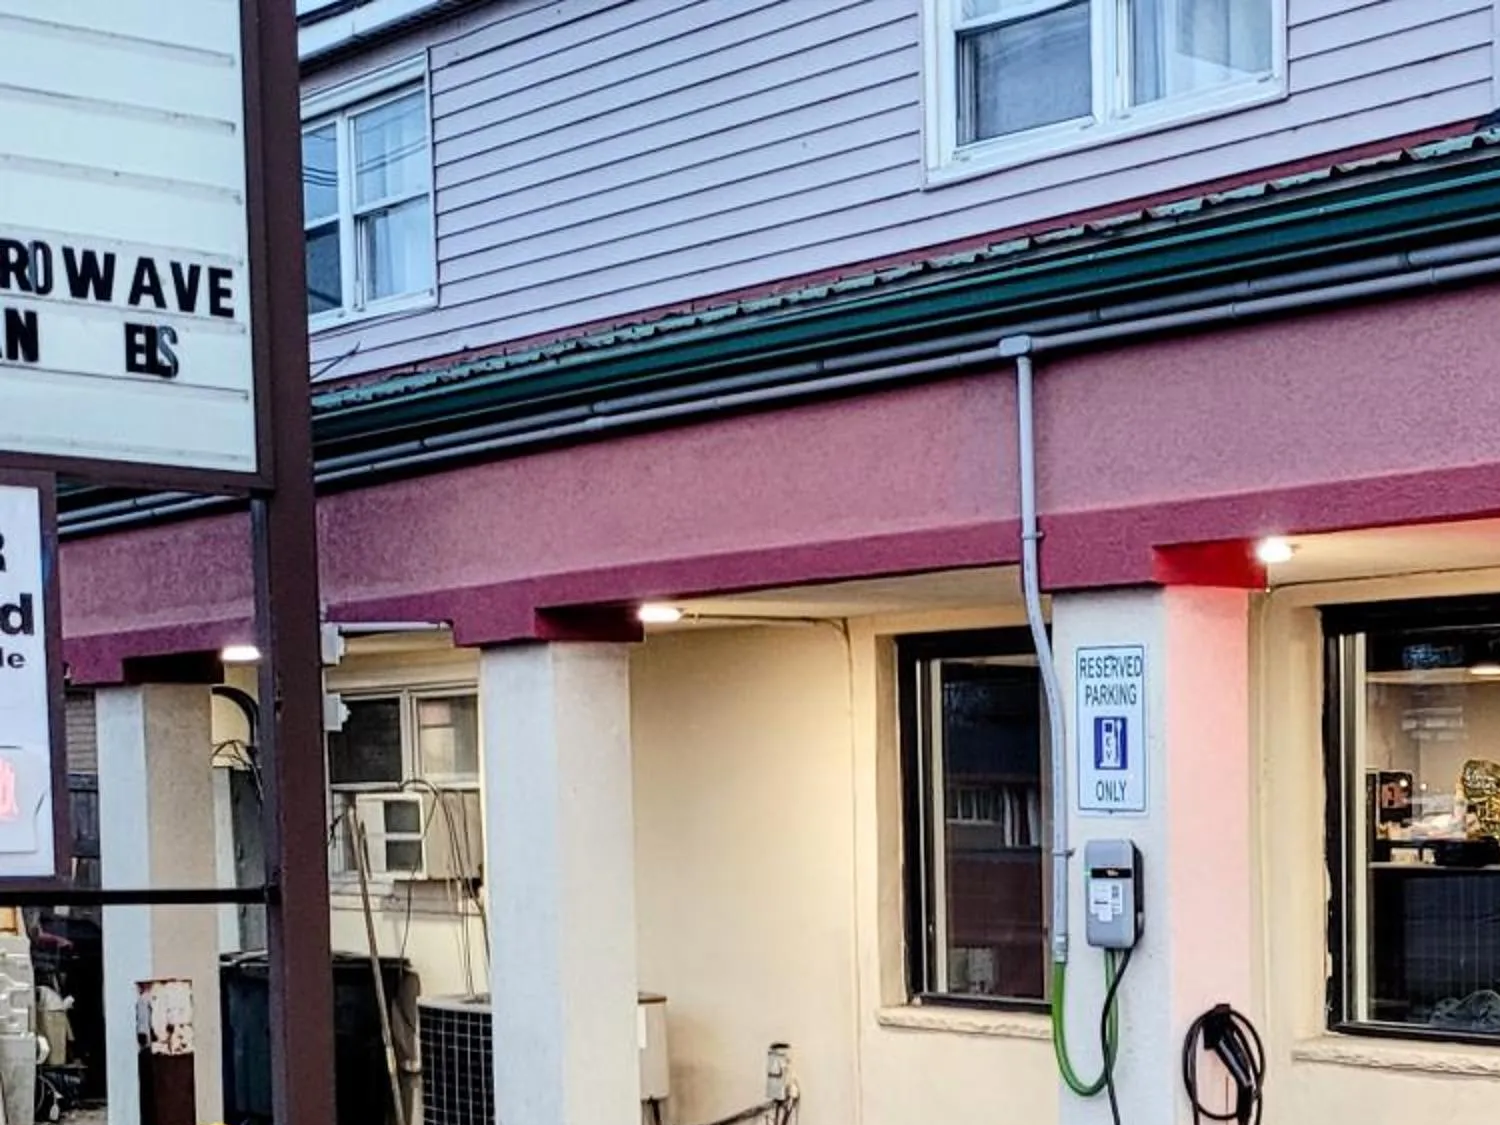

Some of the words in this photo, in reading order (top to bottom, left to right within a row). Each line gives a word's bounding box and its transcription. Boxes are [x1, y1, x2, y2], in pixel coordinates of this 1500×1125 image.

[0, 307, 39, 362] N
[1080, 655, 1141, 679] RESERVED
[1085, 683, 1137, 706] PARKING
[1096, 779, 1127, 802] ONLY
